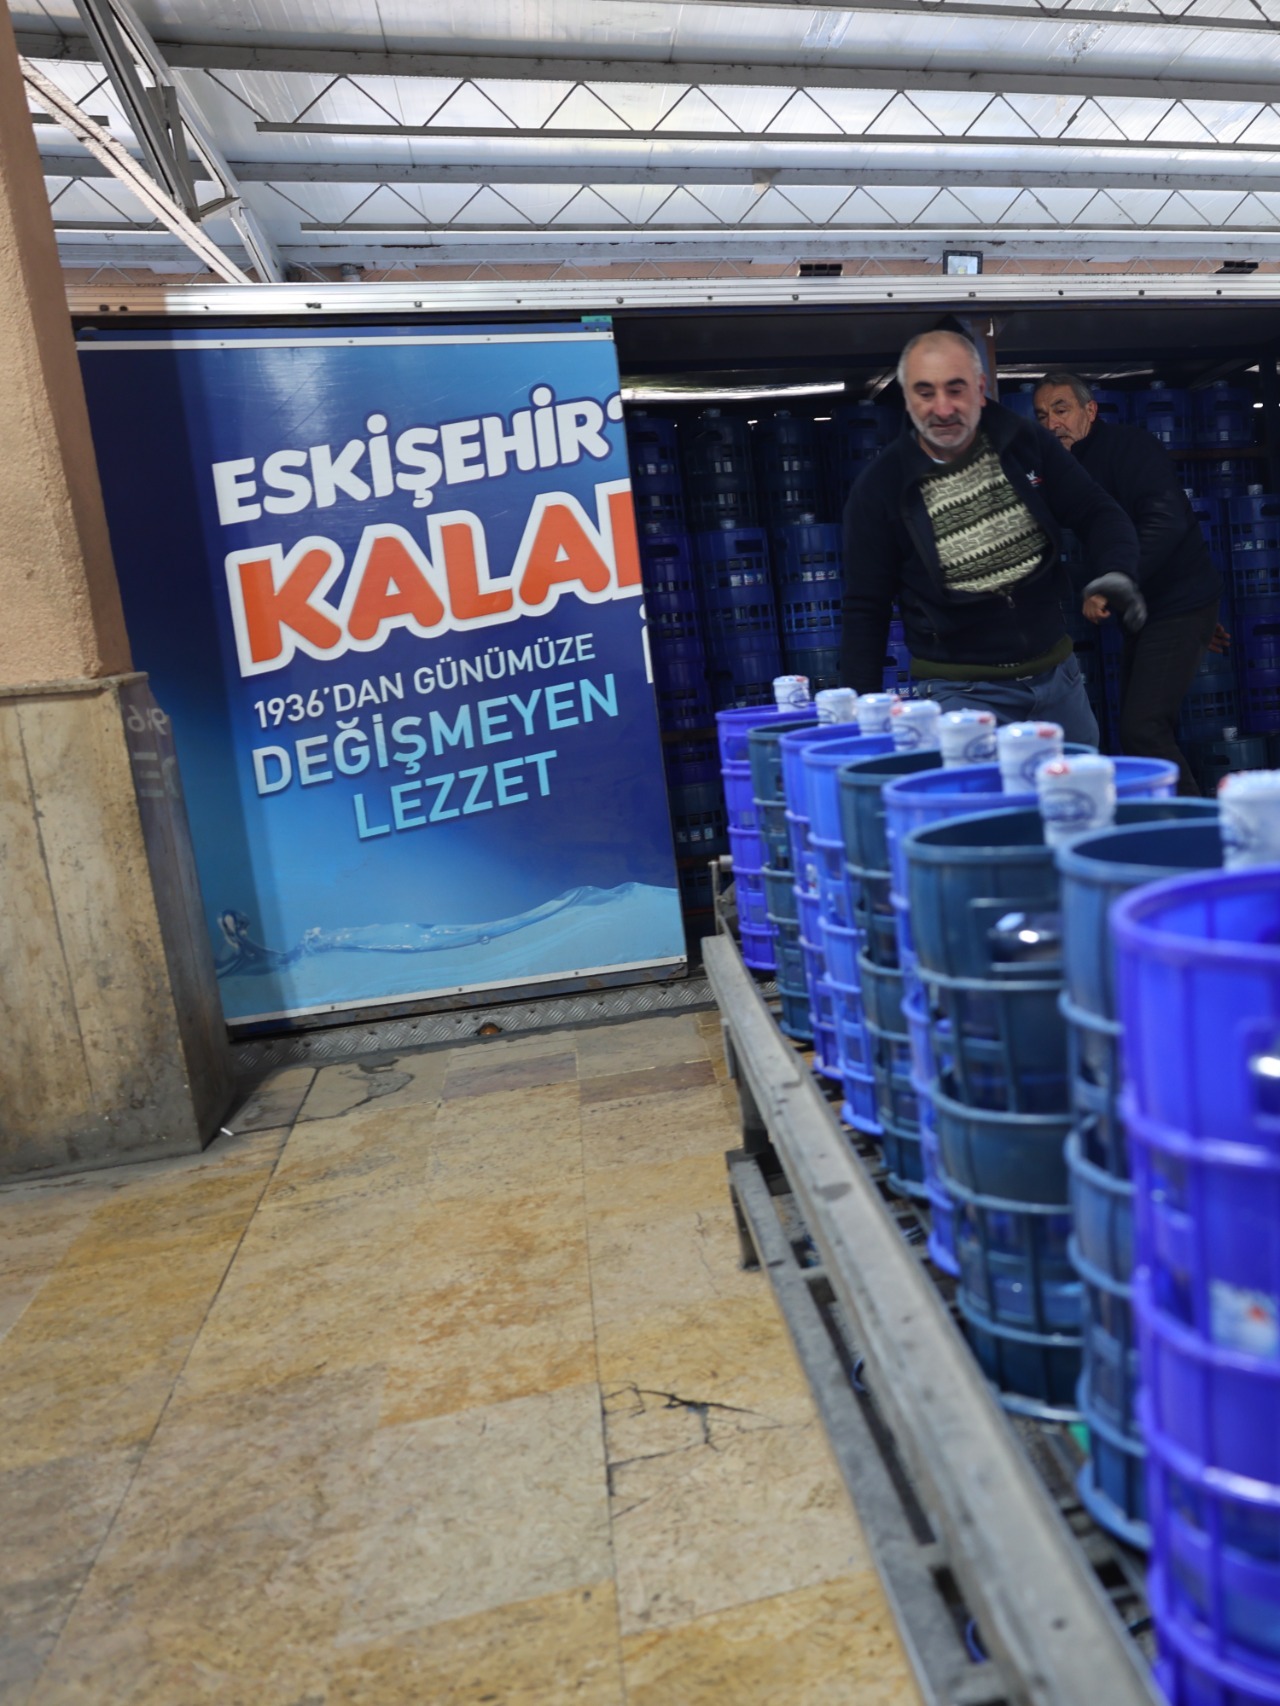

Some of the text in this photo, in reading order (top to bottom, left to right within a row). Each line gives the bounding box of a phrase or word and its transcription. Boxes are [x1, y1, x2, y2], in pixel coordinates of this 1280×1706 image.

[253, 633, 596, 728] 1936'DAN GÜNÜMÜZE
[252, 673, 619, 795] DEĞİŞMEYEN
[353, 750, 558, 840] LEZZET
